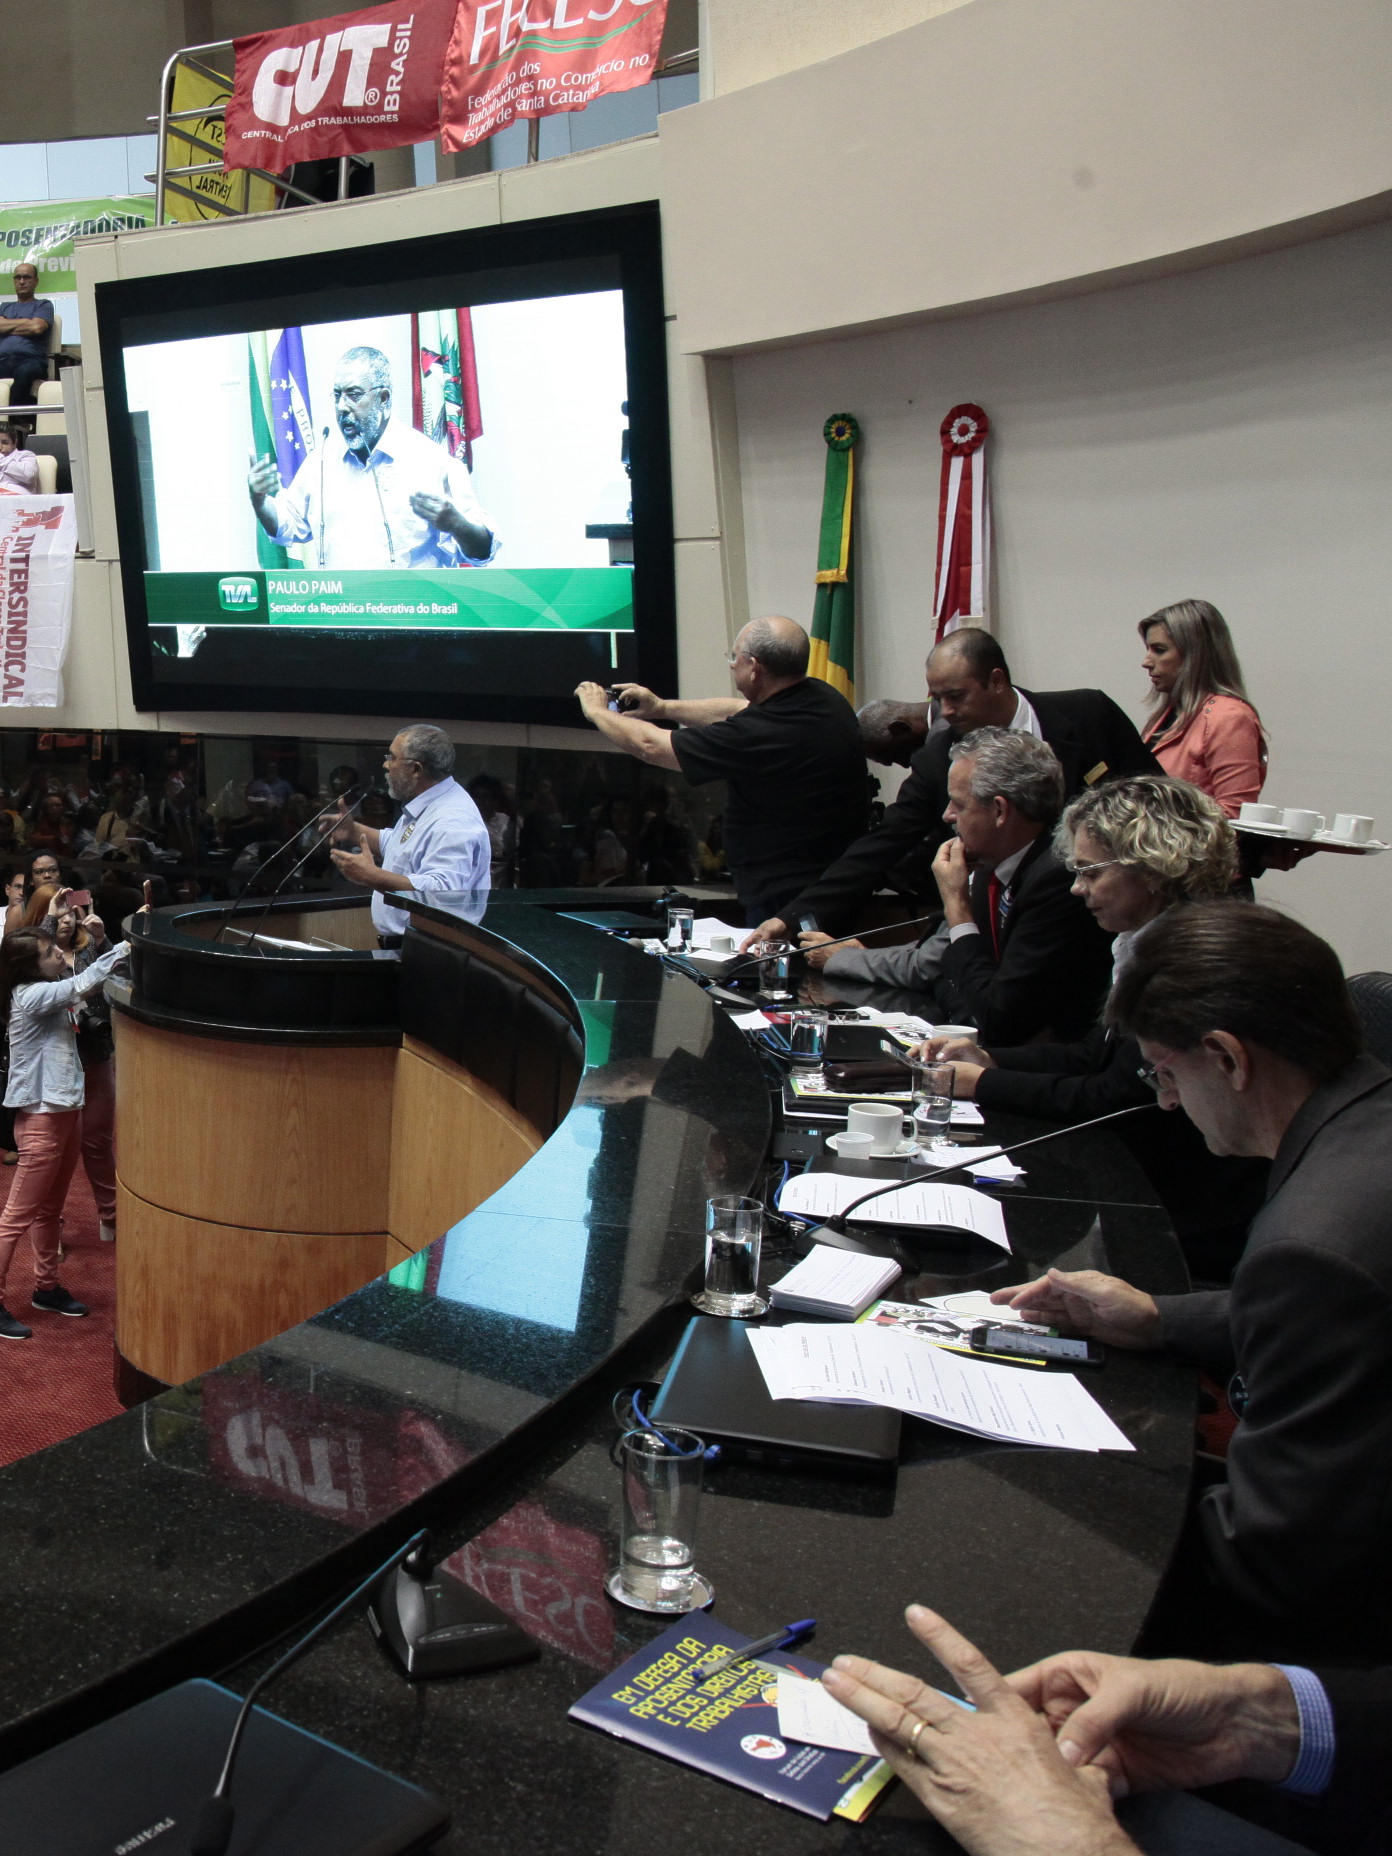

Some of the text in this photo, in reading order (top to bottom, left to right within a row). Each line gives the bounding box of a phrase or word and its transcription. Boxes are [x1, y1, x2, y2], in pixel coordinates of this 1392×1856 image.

[252, 23, 392, 127] CUT
[384, 14, 415, 112] BRASIL
[520, 61, 541, 79] dos
[538, 78, 556, 91] no
[560, 59, 625, 86] Comércio
[629, 53, 650, 70] no
[242, 130, 284, 143] CENTRAL
[317, 114, 399, 126] TRABALHADORES
[496, 107, 512, 124] de
[268, 580, 344, 594] PAULO PAIM
[270, 602, 458, 616] Senador da República Federativa do Brasil
[3, 533, 36, 704] INTERSINDICAL
[611, 1637, 707, 1705] EM DEFESA DA
[656, 1660, 757, 1727] E DOS DIREITOS
[685, 1669, 778, 1733] TRABALHISTAS
